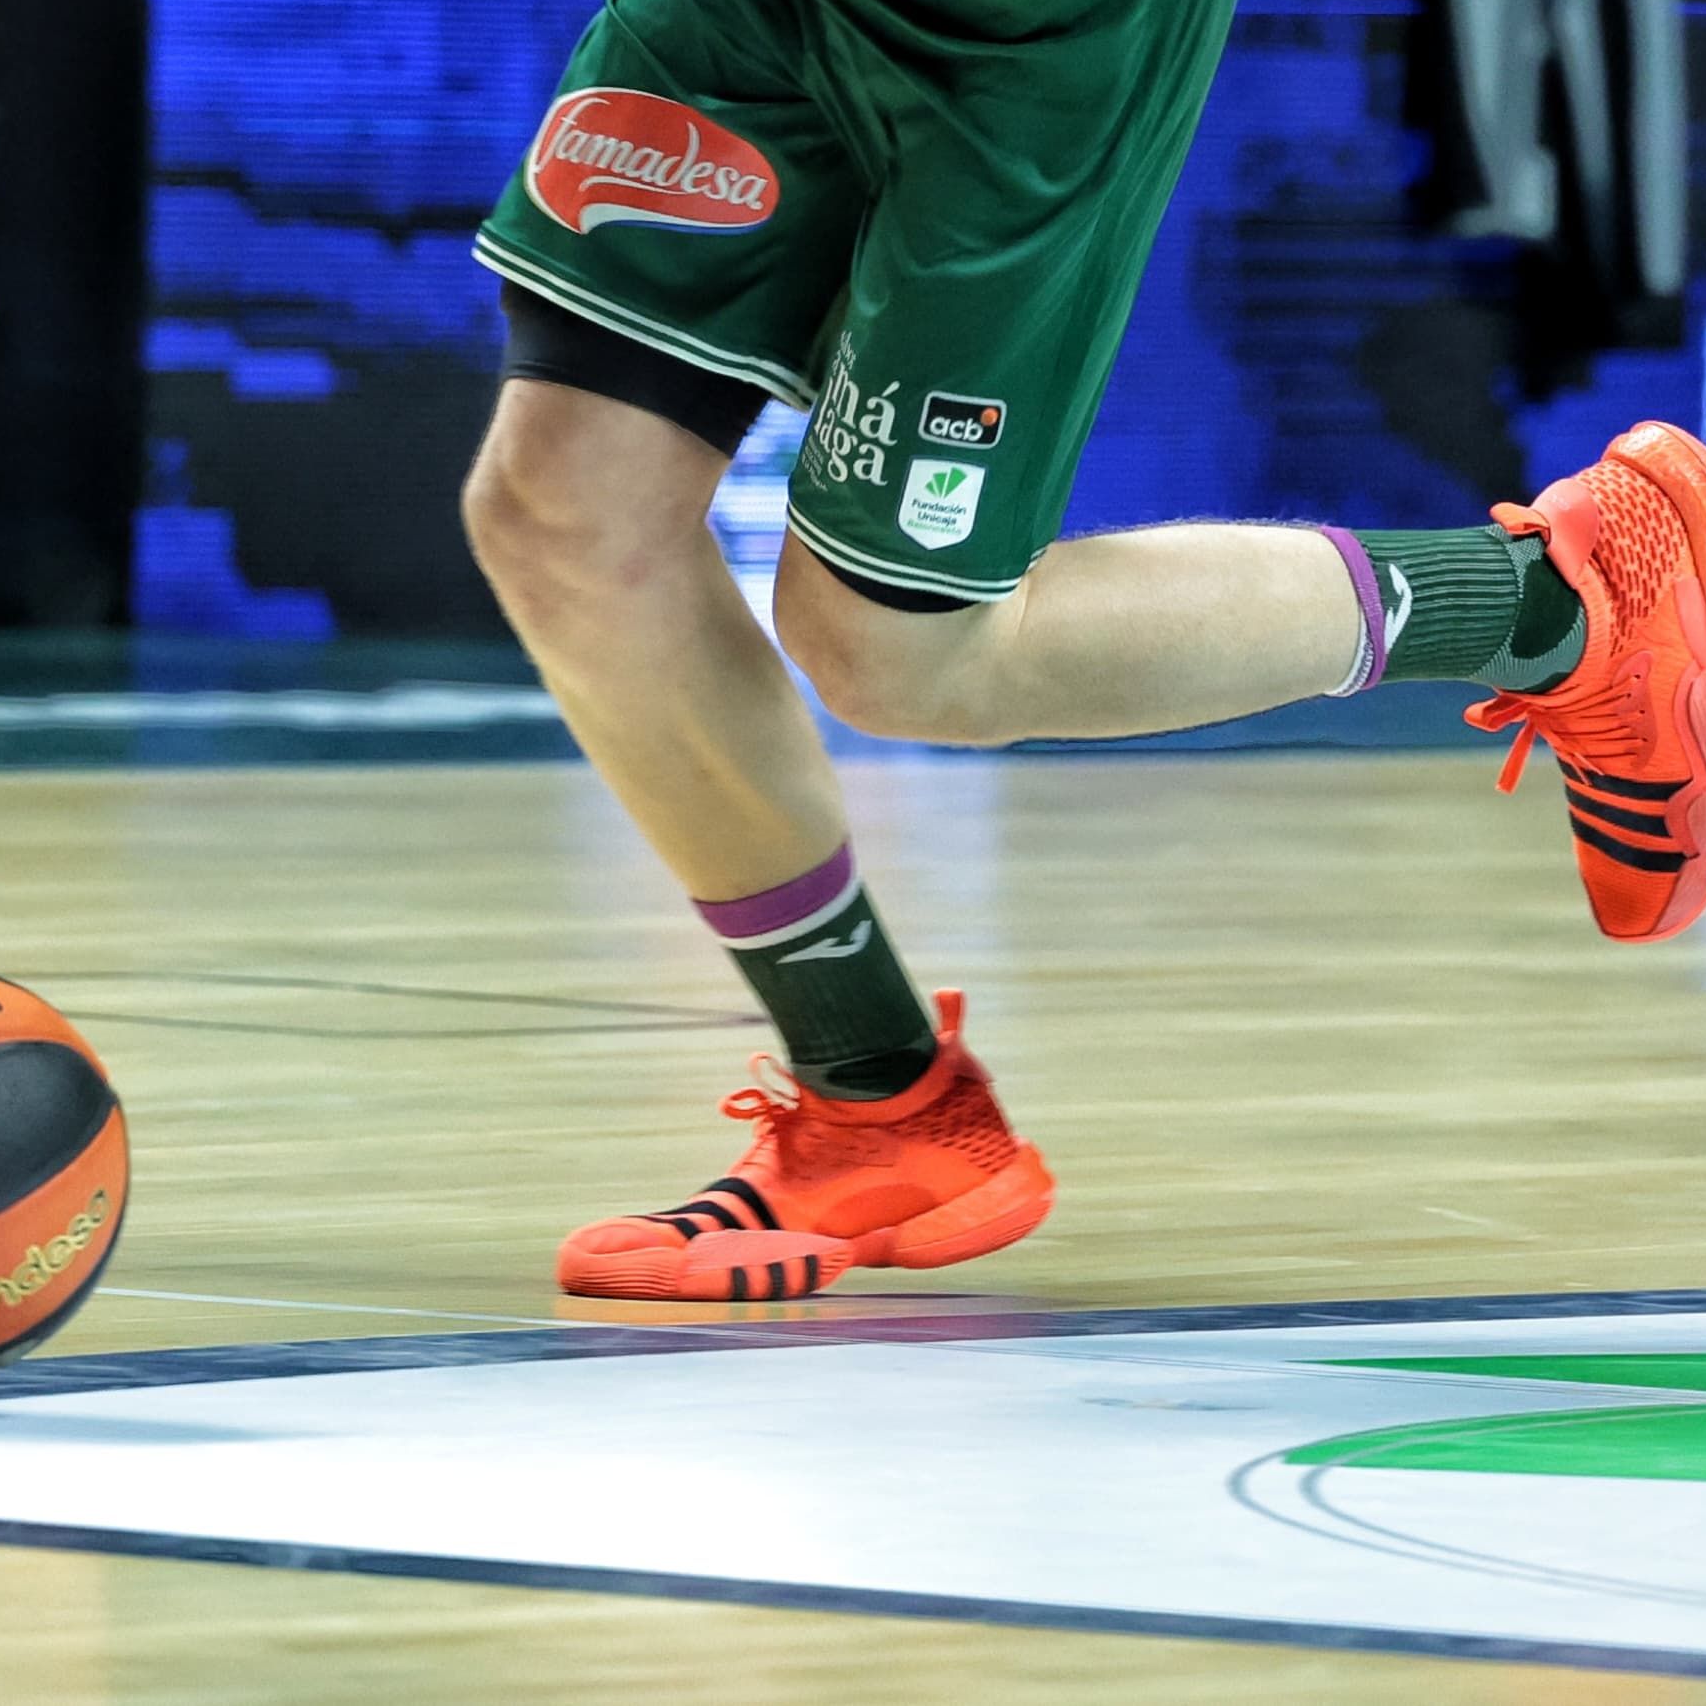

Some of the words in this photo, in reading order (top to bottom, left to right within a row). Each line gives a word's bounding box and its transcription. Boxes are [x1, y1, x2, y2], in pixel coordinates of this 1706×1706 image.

[929, 416, 984, 442] acb
[911, 497, 967, 515] Fundación
[917, 510, 957, 527] Unicaja
